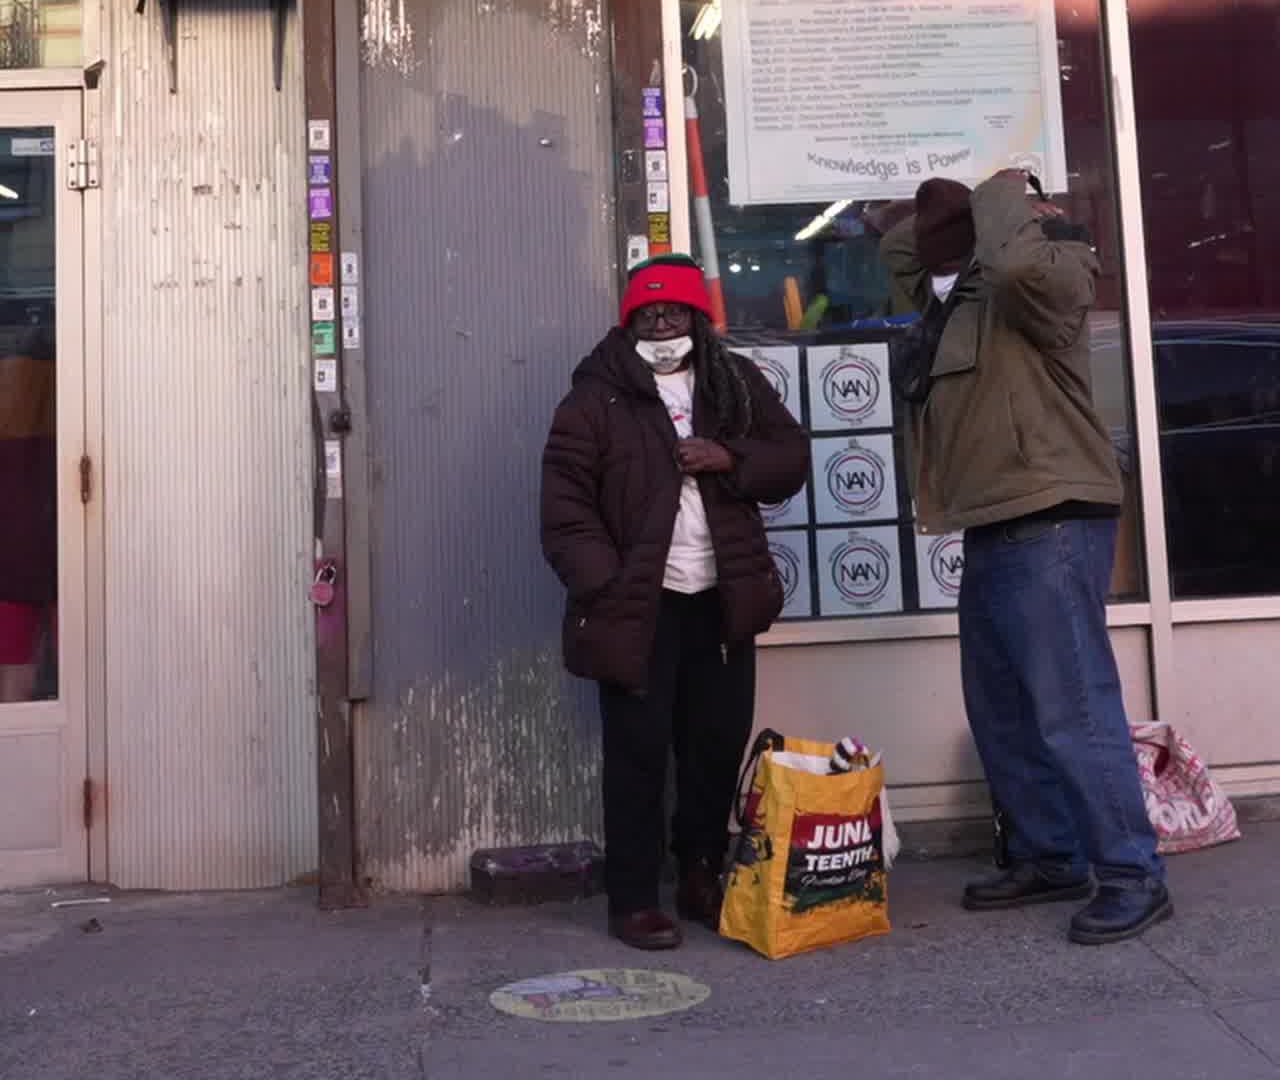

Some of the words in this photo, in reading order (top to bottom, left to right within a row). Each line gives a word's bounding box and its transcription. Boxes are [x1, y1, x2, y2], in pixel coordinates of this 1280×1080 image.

[807, 151, 899, 181] Knowledge
[905, 160, 921, 175] is
[927, 146, 971, 171] Power
[831, 378, 870, 399] NAN
[835, 470, 876, 491] NAN
[840, 561, 880, 582] NAN
[939, 555, 965, 574] NA
[805, 845, 873, 871] TEENTH
